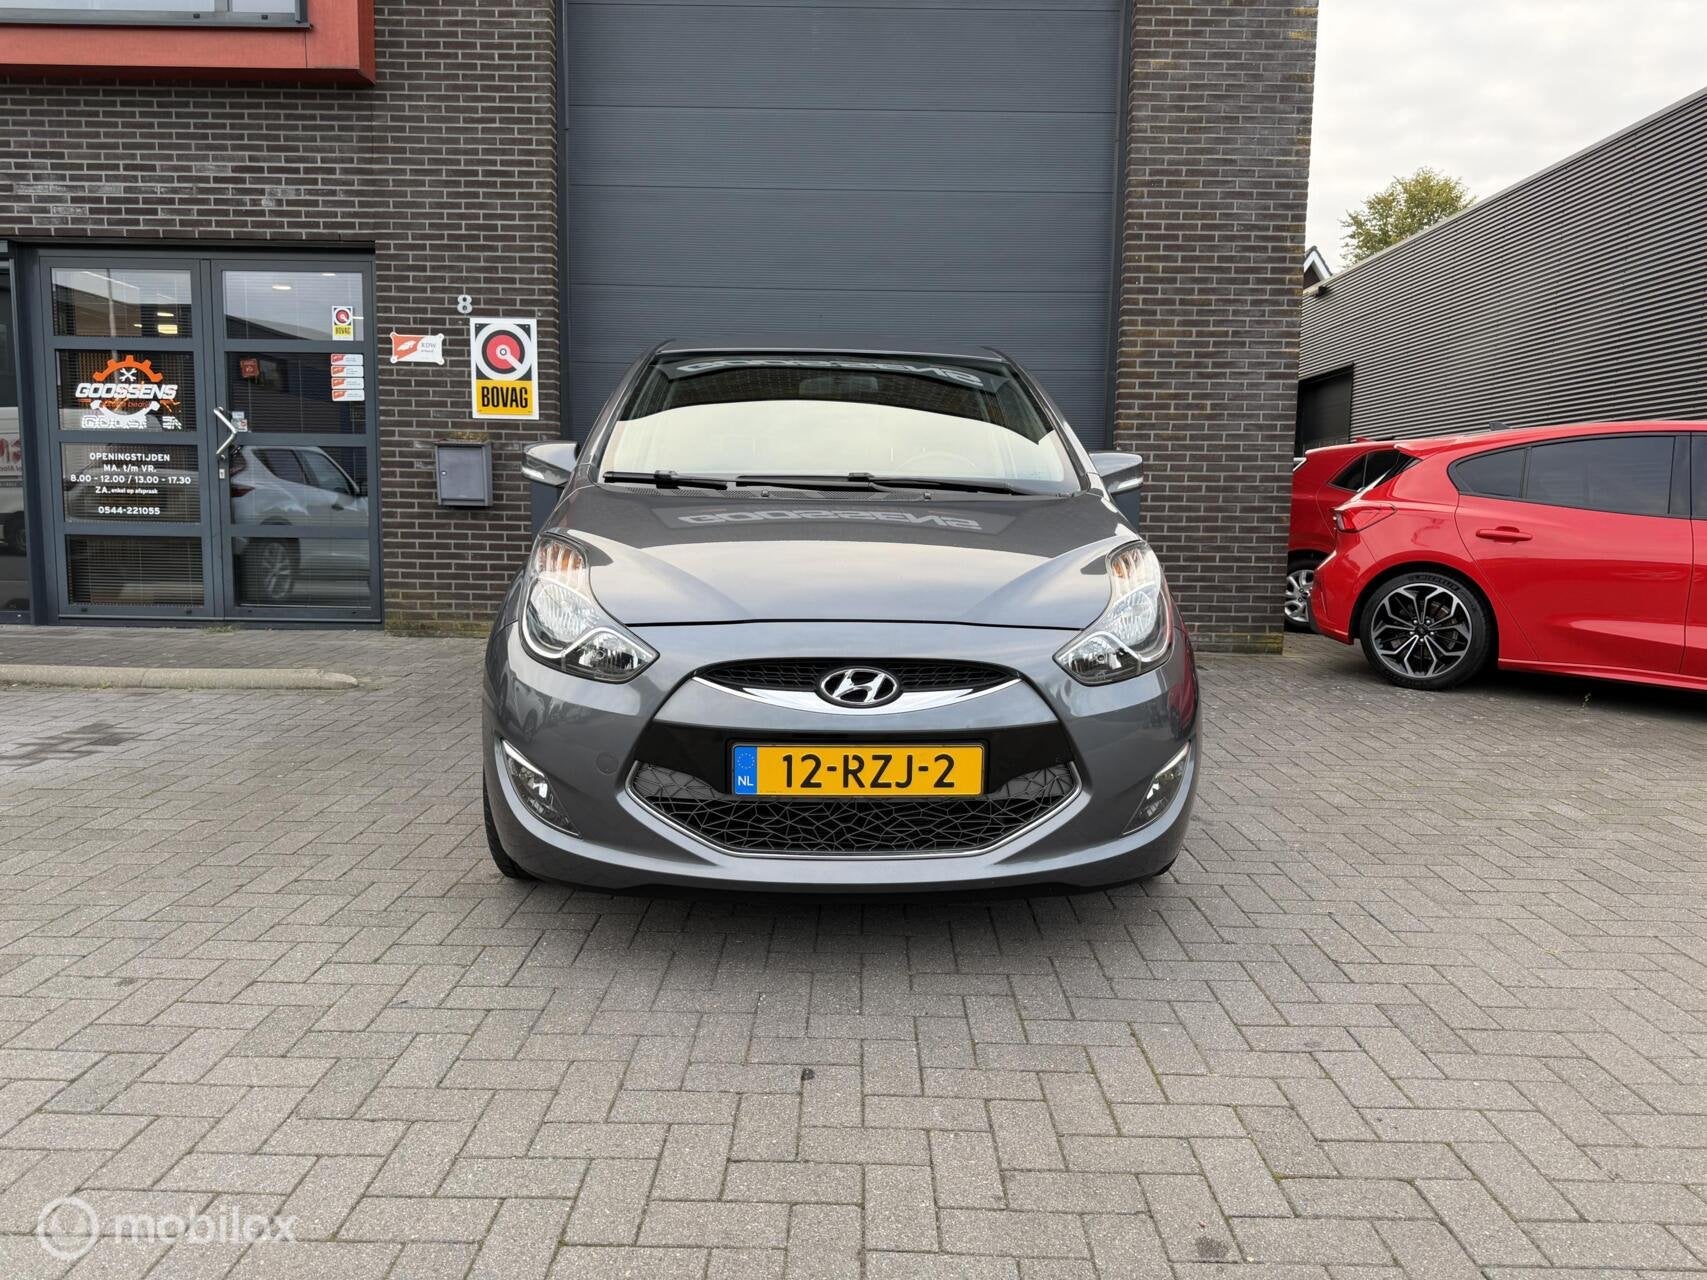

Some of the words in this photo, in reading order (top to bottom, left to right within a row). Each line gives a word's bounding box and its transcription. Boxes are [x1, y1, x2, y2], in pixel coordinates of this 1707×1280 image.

[457, 294, 473, 314] 8
[75, 382, 178, 399] GOOSSENS
[481, 386, 528, 409] BOVAG
[89, 452, 170, 462] OPENINGSTIJDEN
[103, 464, 120, 472] MA.
[123, 464, 138, 473] t/m
[141, 465, 157, 473] VR.
[70, 474, 92, 482] 8.00
[100, 475, 125, 483] 12.00
[134, 475, 159, 483] 13.00
[168, 476, 191, 484] 17.30
[98, 506, 161, 515] 0544-221055
[737, 775, 754, 786] NL
[782, 753, 955, 789] 12-RZJ-2
